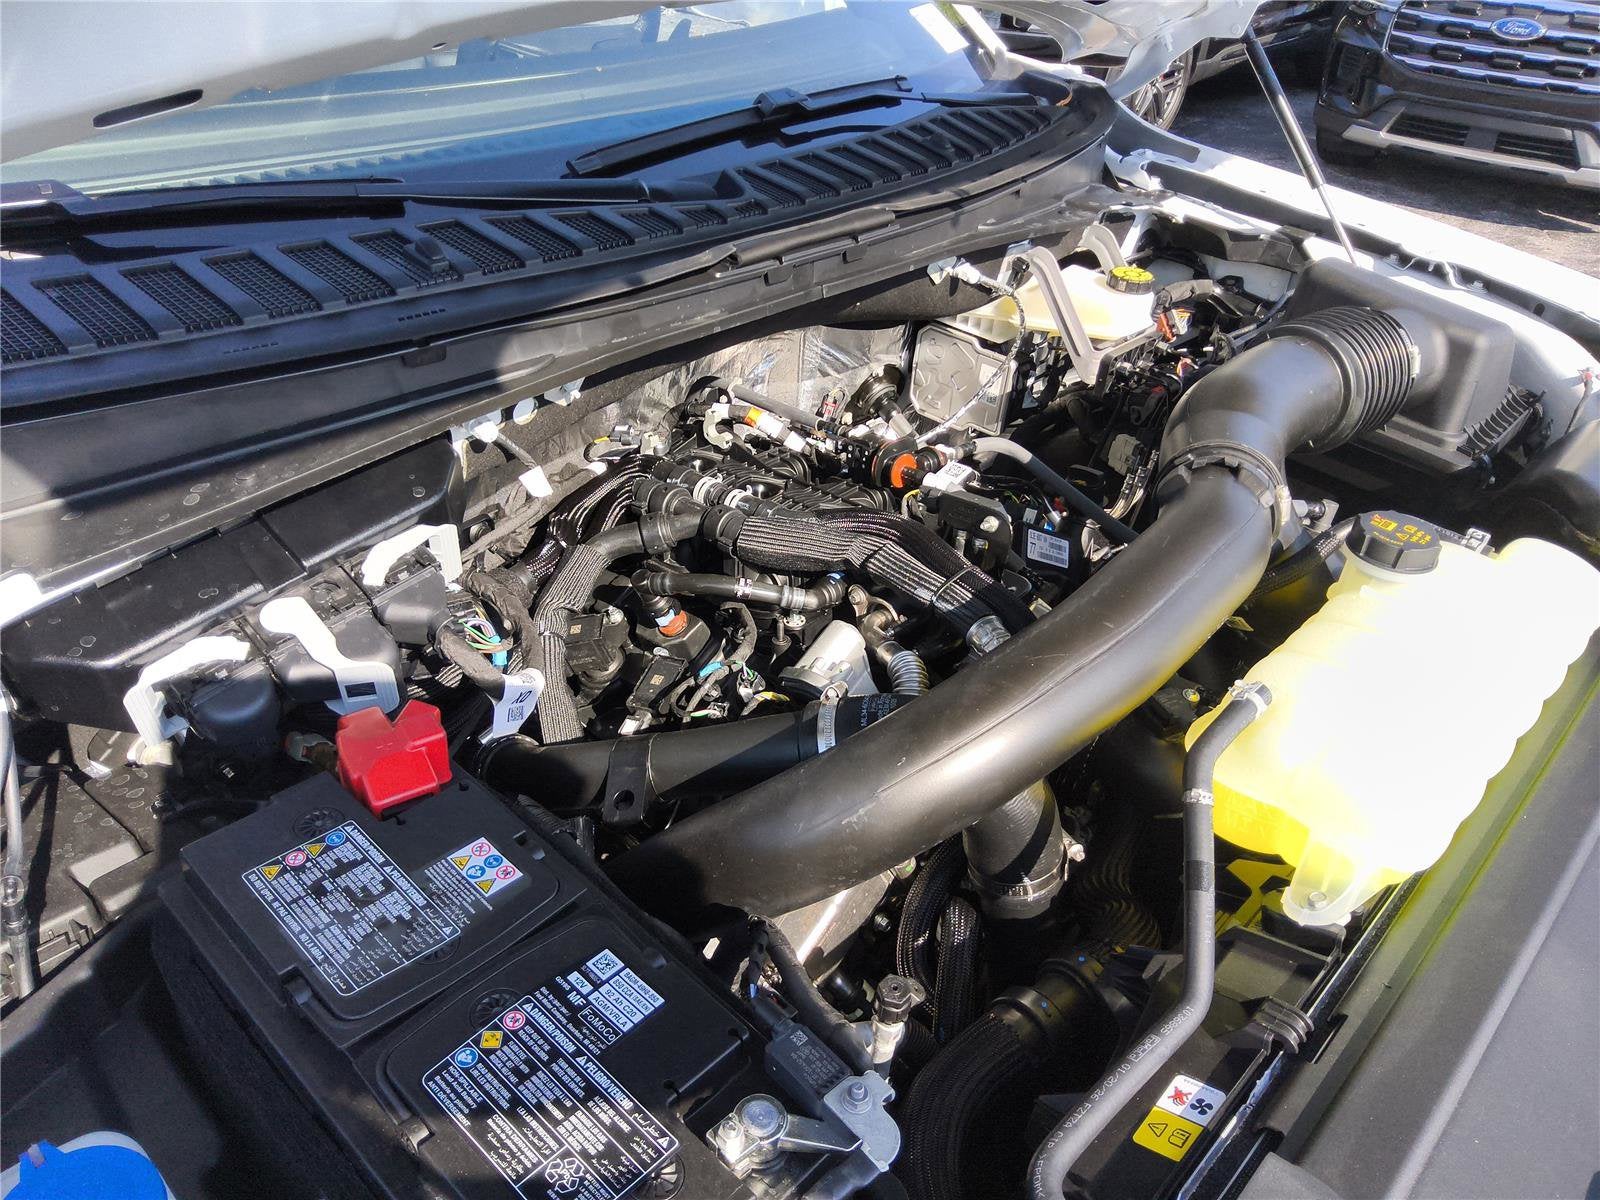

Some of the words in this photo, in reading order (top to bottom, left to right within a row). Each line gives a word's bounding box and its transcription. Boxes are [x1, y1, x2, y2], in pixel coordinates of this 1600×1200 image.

[573, 977, 586, 988] 12V
[622, 987, 633, 996] CCA
[566, 991, 586, 1007] MF
[593, 996, 627, 1026] AGM/VRLA
[605, 989, 614, 997] 92
[613, 997, 624, 1005] Ah
[622, 1005, 636, 1016] C20
[529, 1008, 576, 1052] DANGER/POISON
[582, 1009, 617, 1040] FoMoCo
[447, 1066, 482, 1102] NON-SPILLABLE
[583, 1061, 633, 1109] PELIGRO/VENENO
[1091, 1062, 1130, 1101] 01/20/26
[427, 1080, 439, 1092] ANTI
[437, 1092, 470, 1127] DÉVERSEMENT
[454, 1098, 470, 1114] plomb
[492, 1114, 512, 1135] CONTRA
[510, 1134, 538, 1162] DERRAMES
[559, 1168, 571, 1179] Pb
